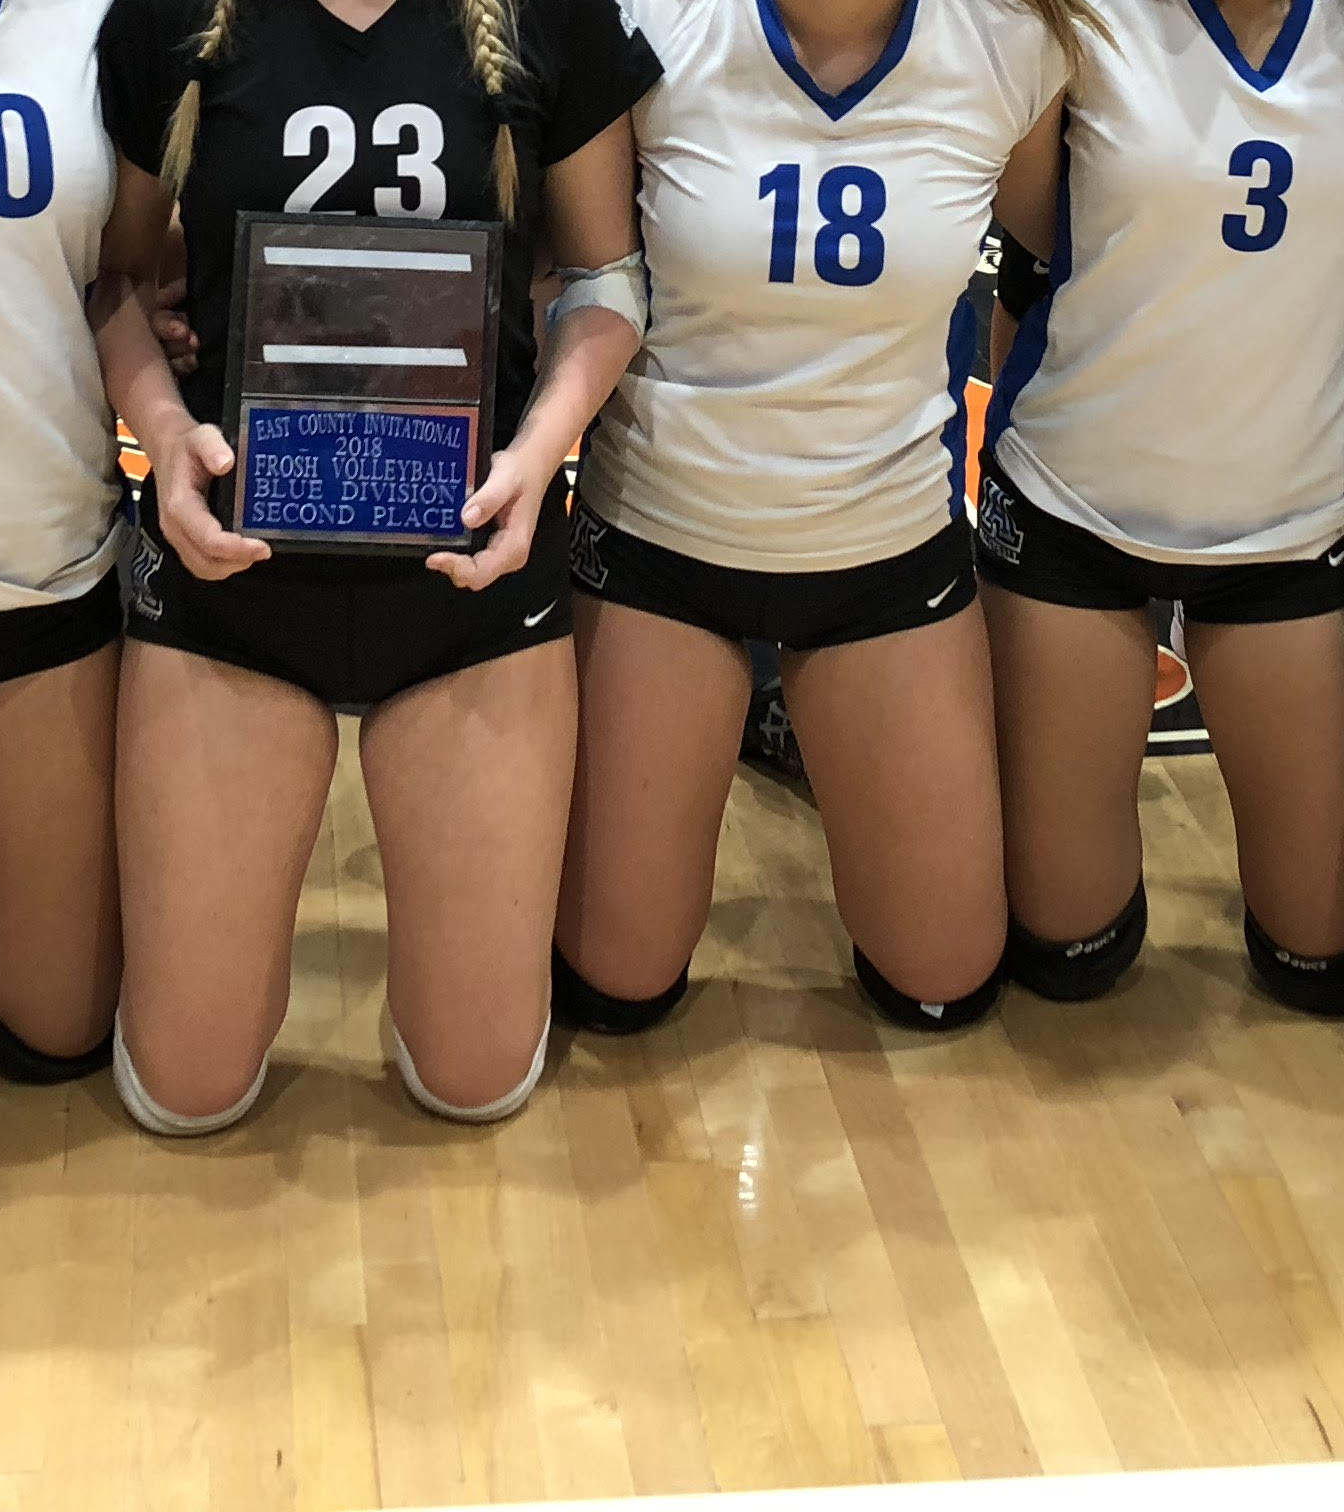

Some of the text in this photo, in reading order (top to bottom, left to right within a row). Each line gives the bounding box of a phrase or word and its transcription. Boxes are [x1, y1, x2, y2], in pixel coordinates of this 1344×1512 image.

[283, 103, 447, 220] 23
[1222, 140, 1294, 252] 3
[759, 164, 886, 285] 18
[256, 413, 461, 448] EAST COUNTY INVITATIONAL
[335, 436, 383, 457] 2018
[254, 454, 462, 484] FROSH VOLLEYBALL
[254, 478, 457, 504] BLUE DIVISION
[252, 502, 455, 528] SECOND PLACE
